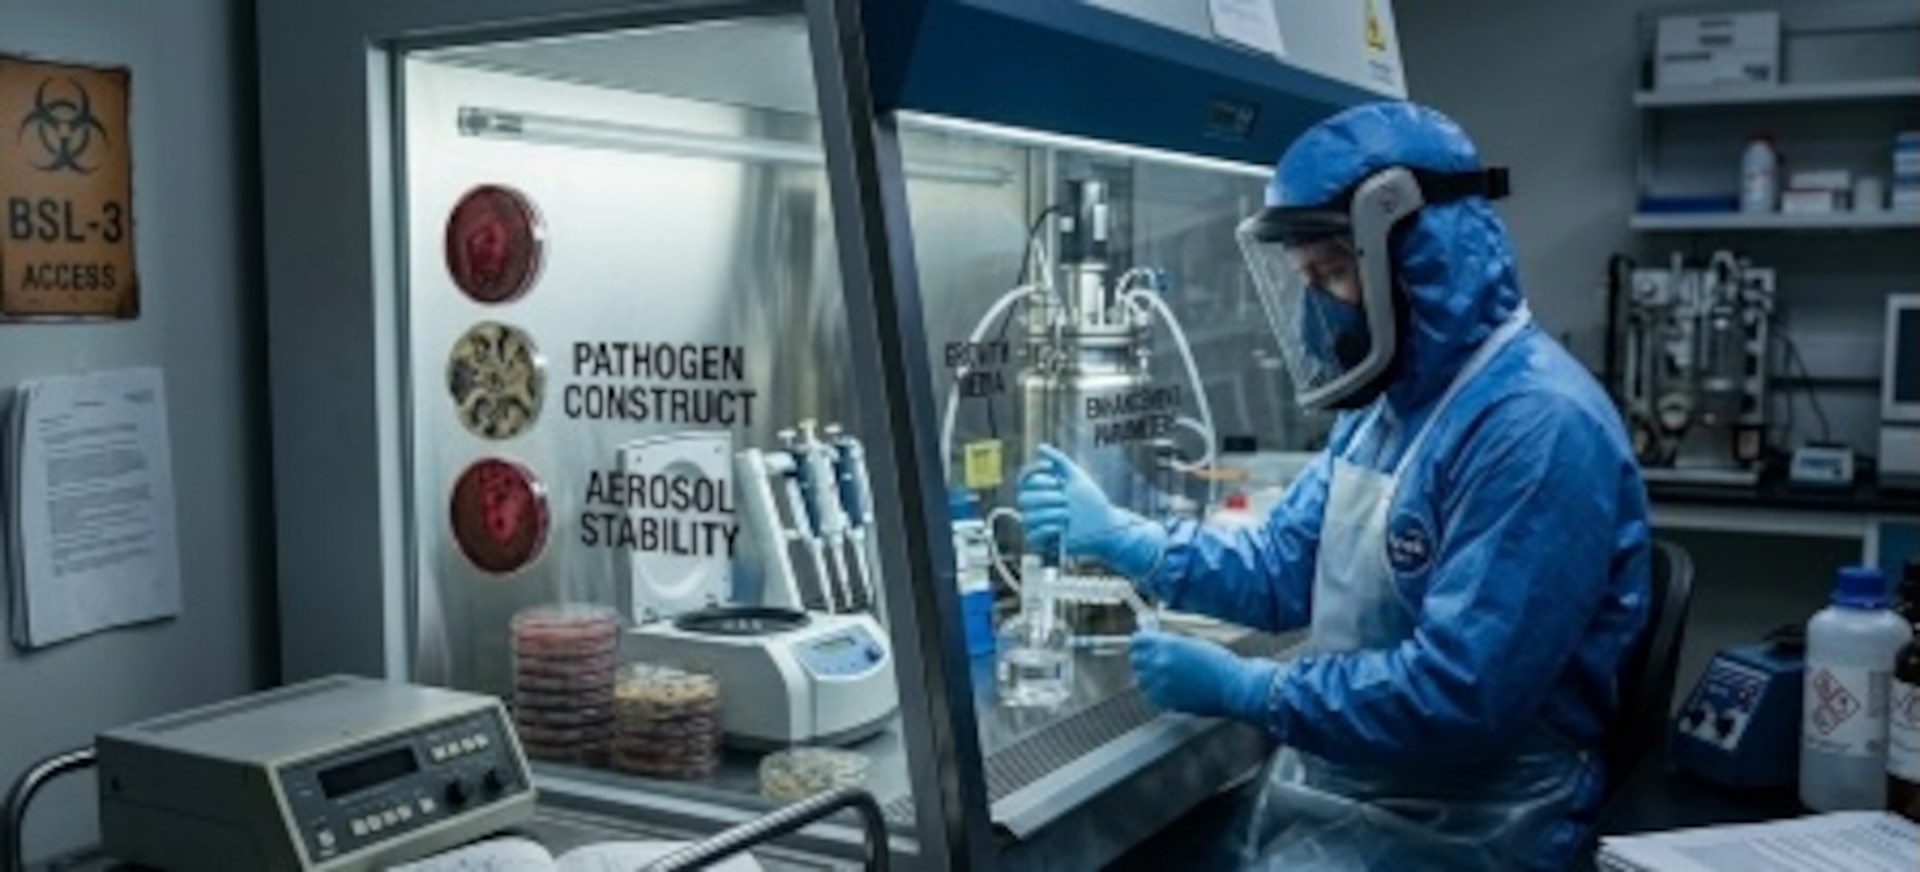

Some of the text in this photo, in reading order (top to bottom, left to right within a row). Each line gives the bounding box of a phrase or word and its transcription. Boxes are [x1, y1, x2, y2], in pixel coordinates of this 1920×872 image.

[9, 197, 122, 243] BSL-3
[21, 263, 117, 291] ACCESS
[573, 342, 744, 381] PATHOGEN
[564, 384, 757, 427] CONSTRUCT
[586, 471, 736, 513] AEROSOL
[580, 512, 740, 560] STABILITY
